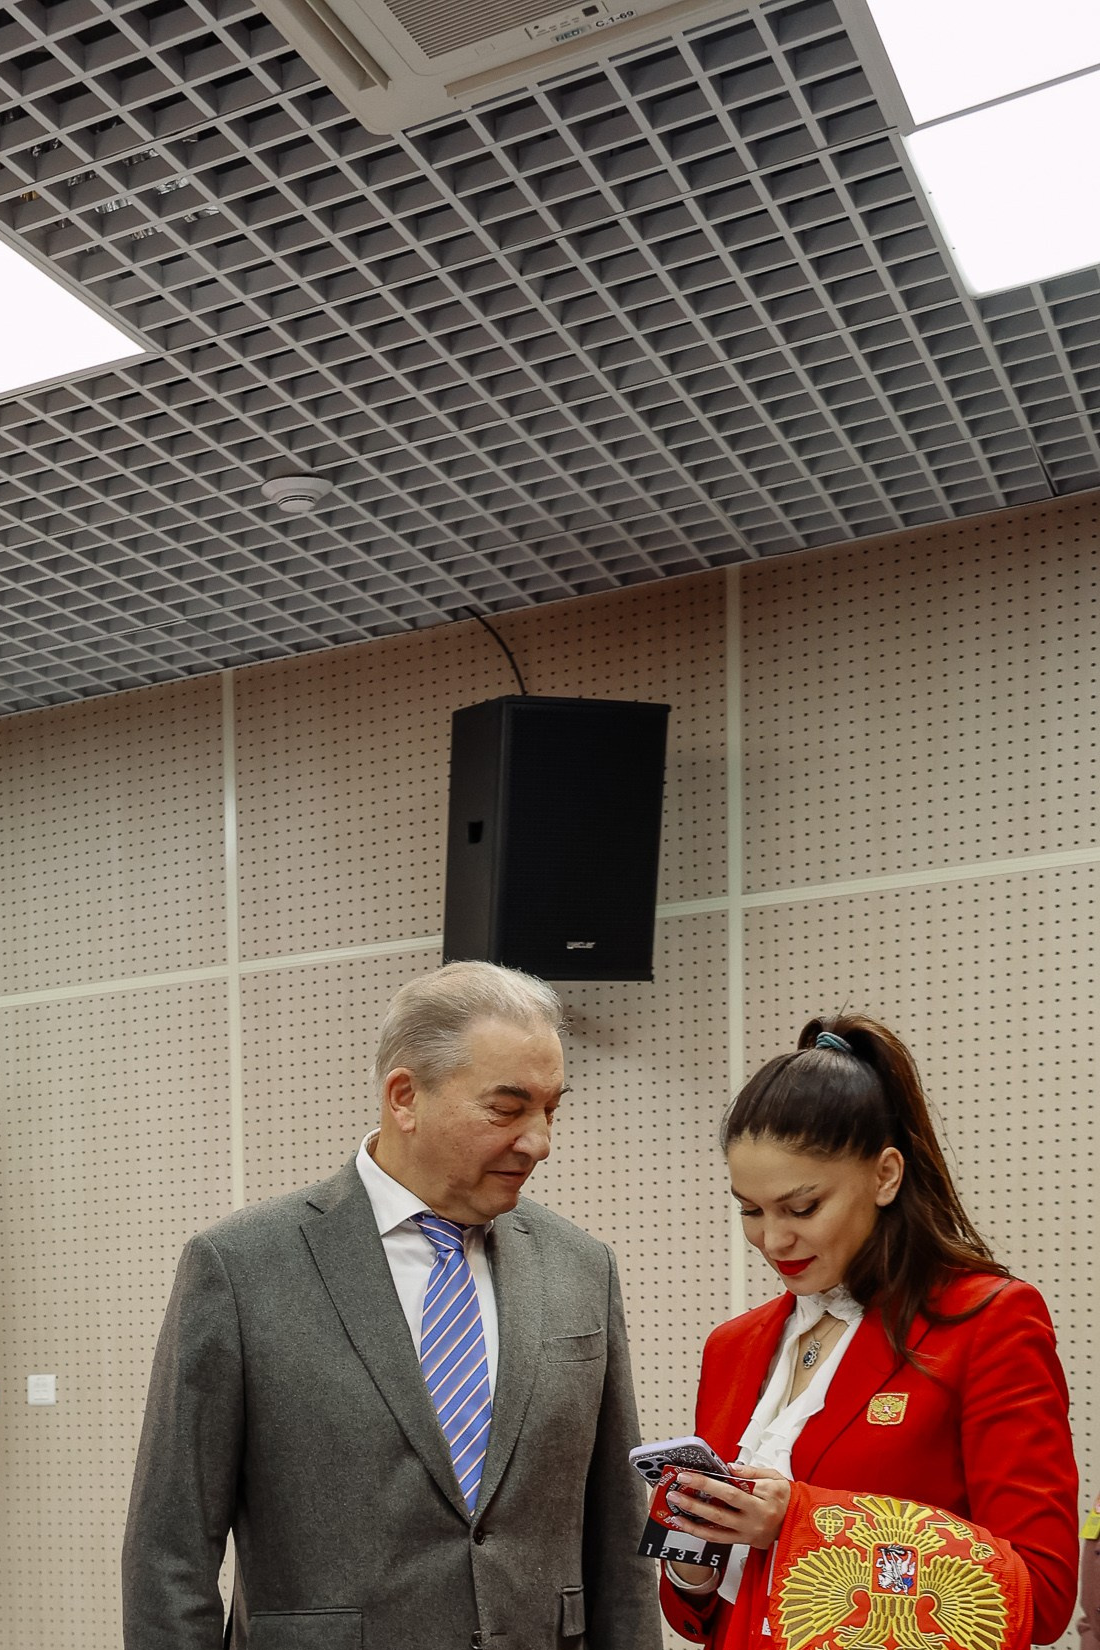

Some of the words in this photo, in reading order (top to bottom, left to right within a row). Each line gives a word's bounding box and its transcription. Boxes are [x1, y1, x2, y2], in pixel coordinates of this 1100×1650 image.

[646, 1543, 653, 1555] 1
[660, 1546, 670, 1558] 2
[675, 1549, 686, 1561] 3
[693, 1552, 702, 1563] 4
[710, 1554, 720, 1566] 5
